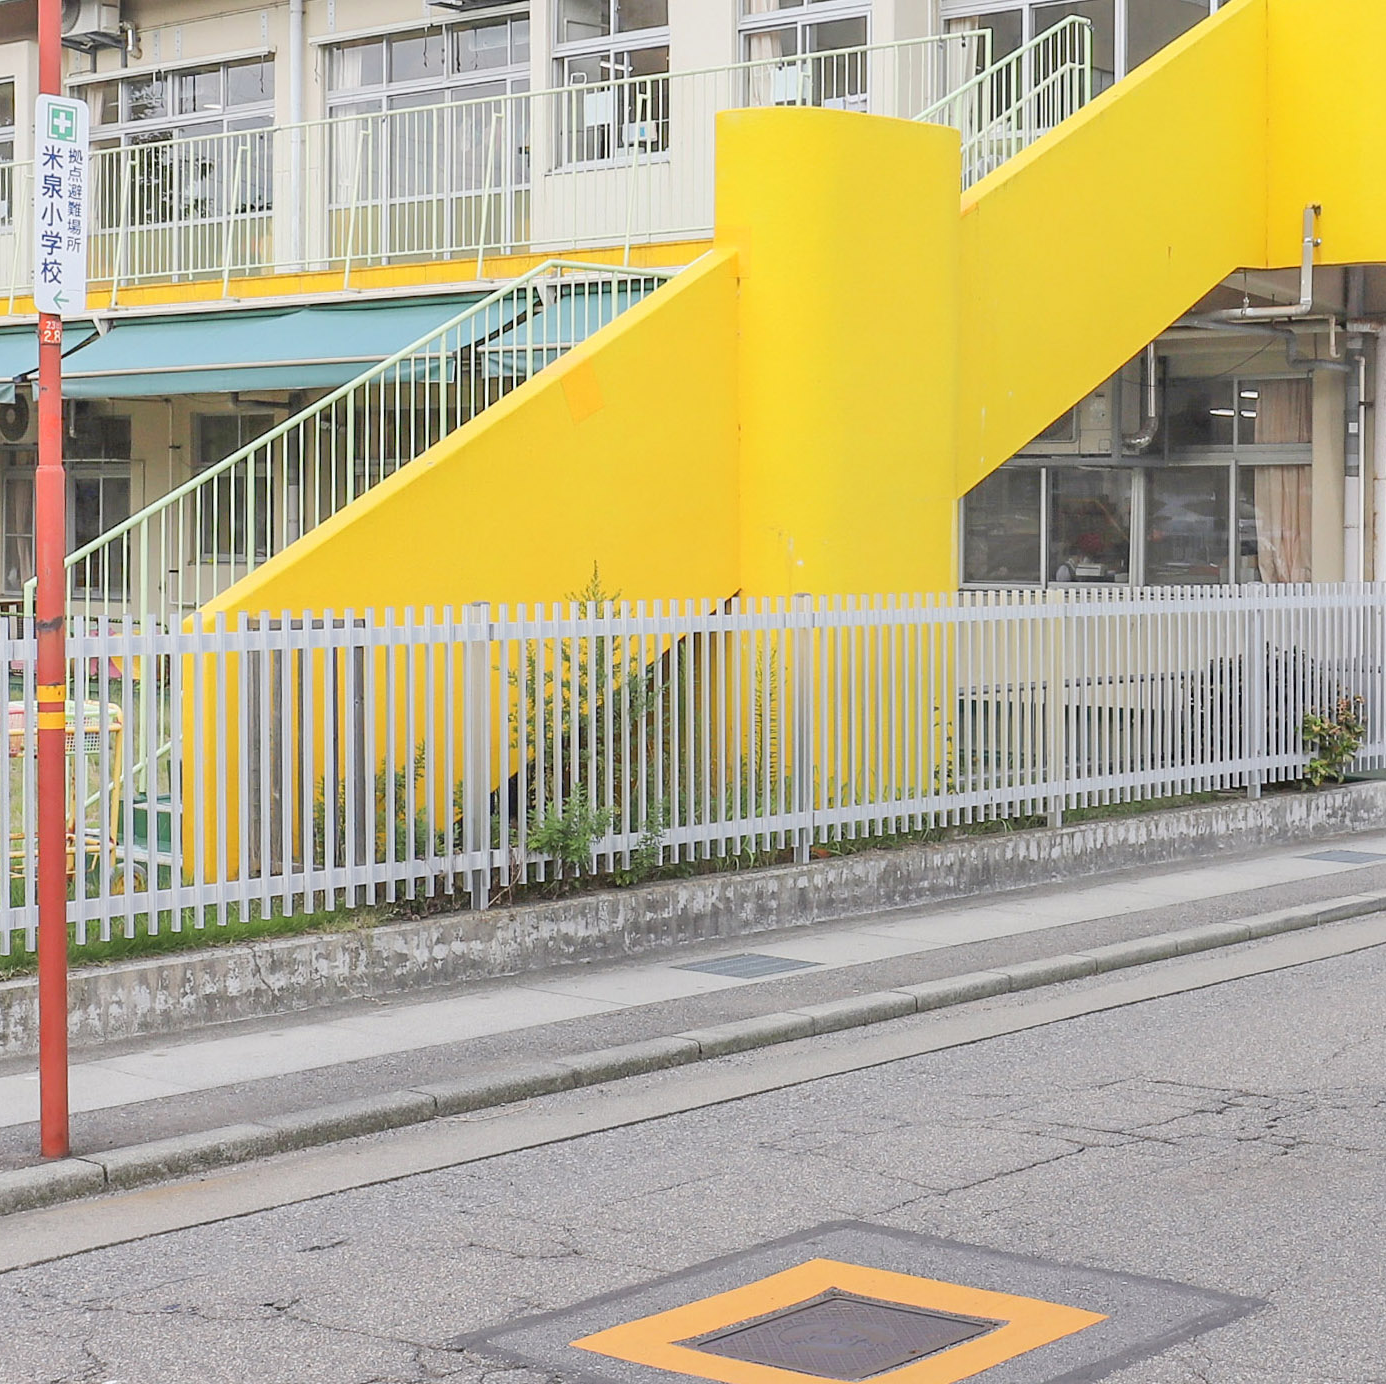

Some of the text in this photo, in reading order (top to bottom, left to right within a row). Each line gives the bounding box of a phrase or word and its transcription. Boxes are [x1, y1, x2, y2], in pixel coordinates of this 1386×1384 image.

[40, 144, 64, 285] 米泉小学校
[66, 147, 84, 254] 拠点避難場所
